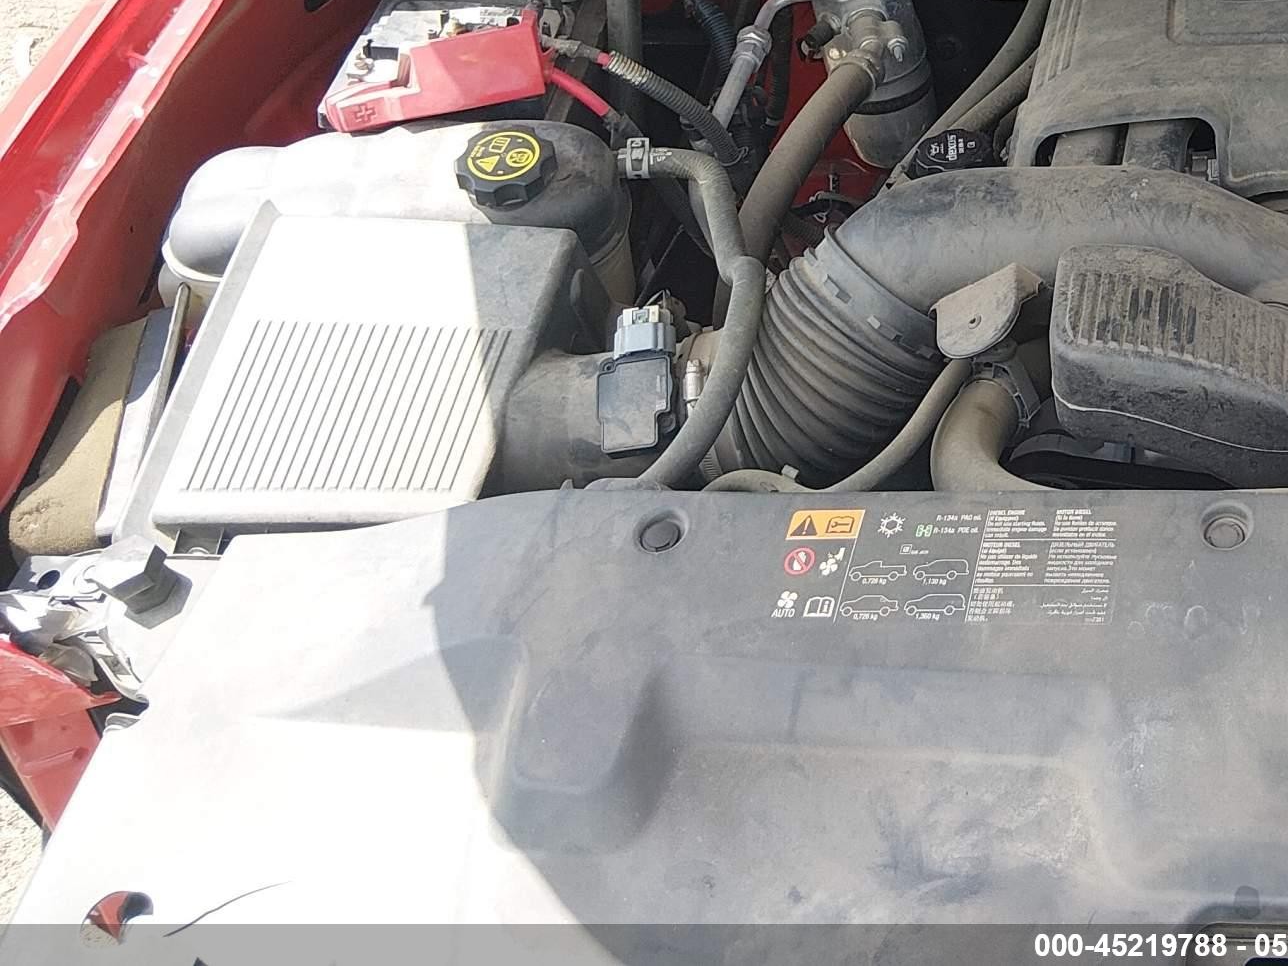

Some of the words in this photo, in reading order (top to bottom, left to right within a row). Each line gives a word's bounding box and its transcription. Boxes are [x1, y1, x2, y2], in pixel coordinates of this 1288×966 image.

[879, 578, 888, 586] kg
[939, 578, 947, 586] kg
[770, 608, 796, 618] AUTO
[870, 613, 878, 621] kg
[932, 612, 941, 621] kg
